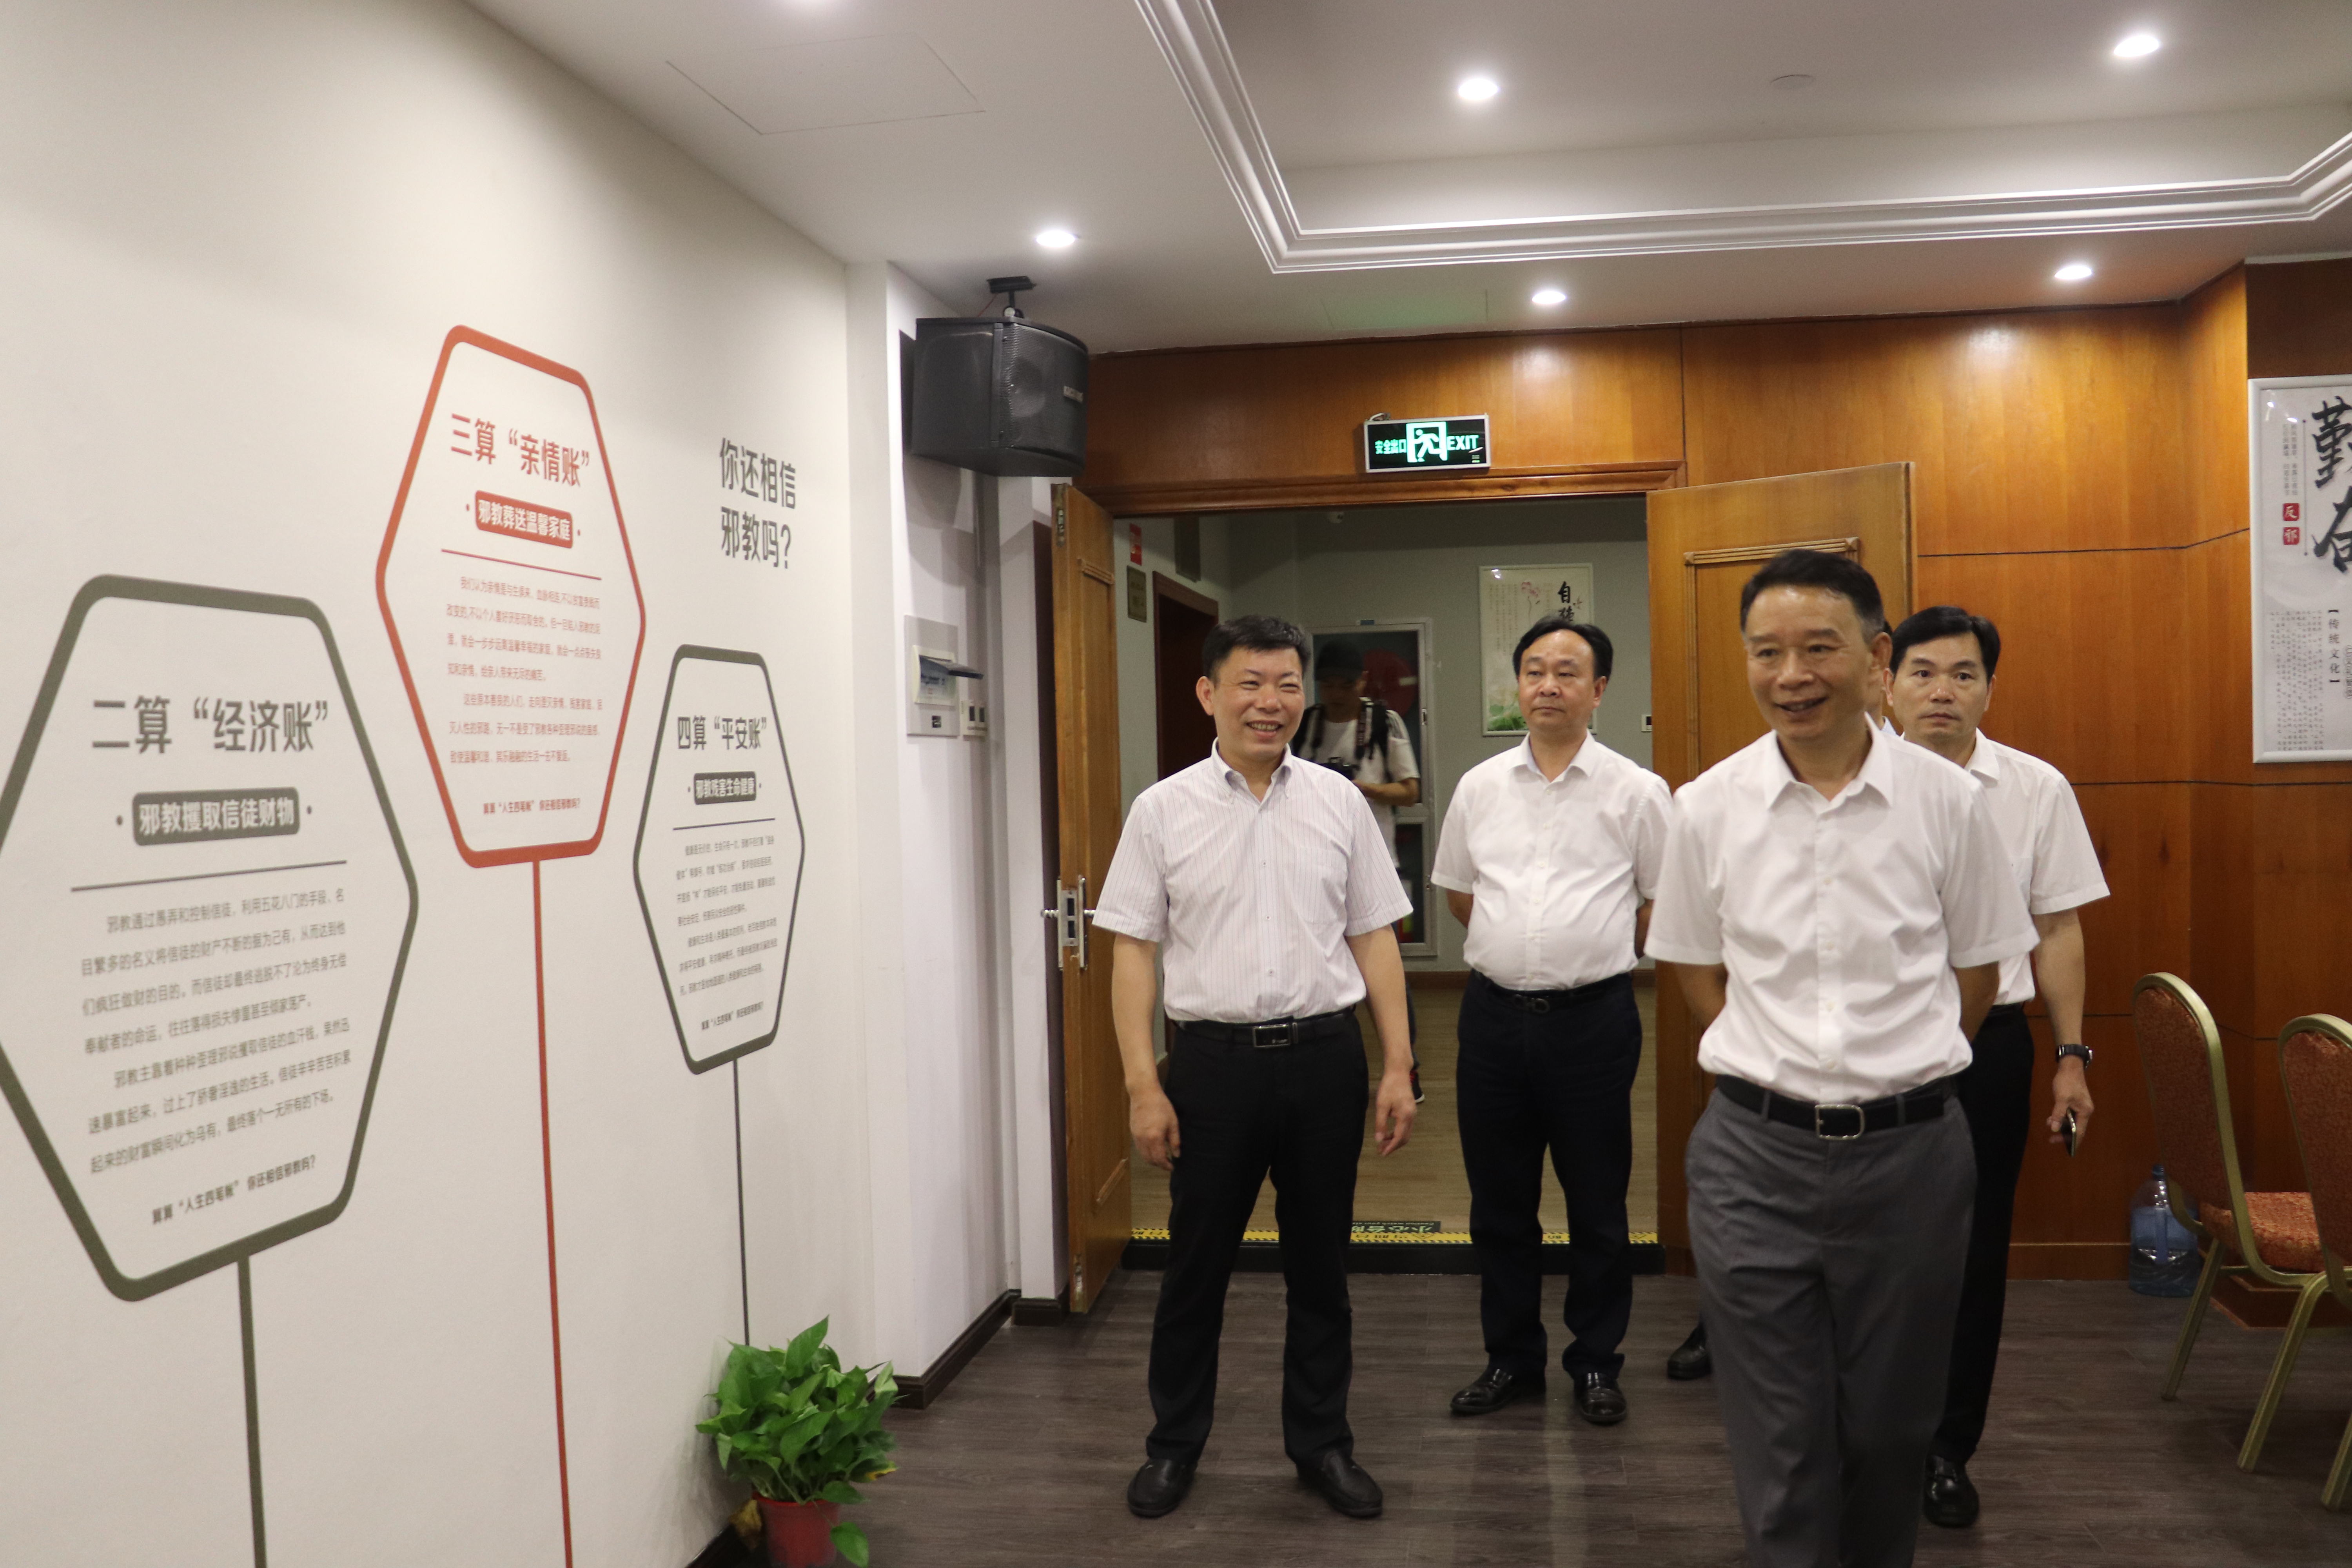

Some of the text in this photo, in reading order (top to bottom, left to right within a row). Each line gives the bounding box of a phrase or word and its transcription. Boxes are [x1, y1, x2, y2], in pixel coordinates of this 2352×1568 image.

[451, 414, 590, 486] 三算“亲情账”
[1375, 439, 1406, 454] 安全出口
[1447, 435, 1479, 450] EXIT
[719, 437, 796, 509] 你还相信
[478, 499, 570, 541] 邪教葬送温馨家庭
[721, 506, 791, 569] 邪教吗？
[93, 696, 328, 755] 二算“经济账”
[678, 716, 767, 750] 四算“平安账”
